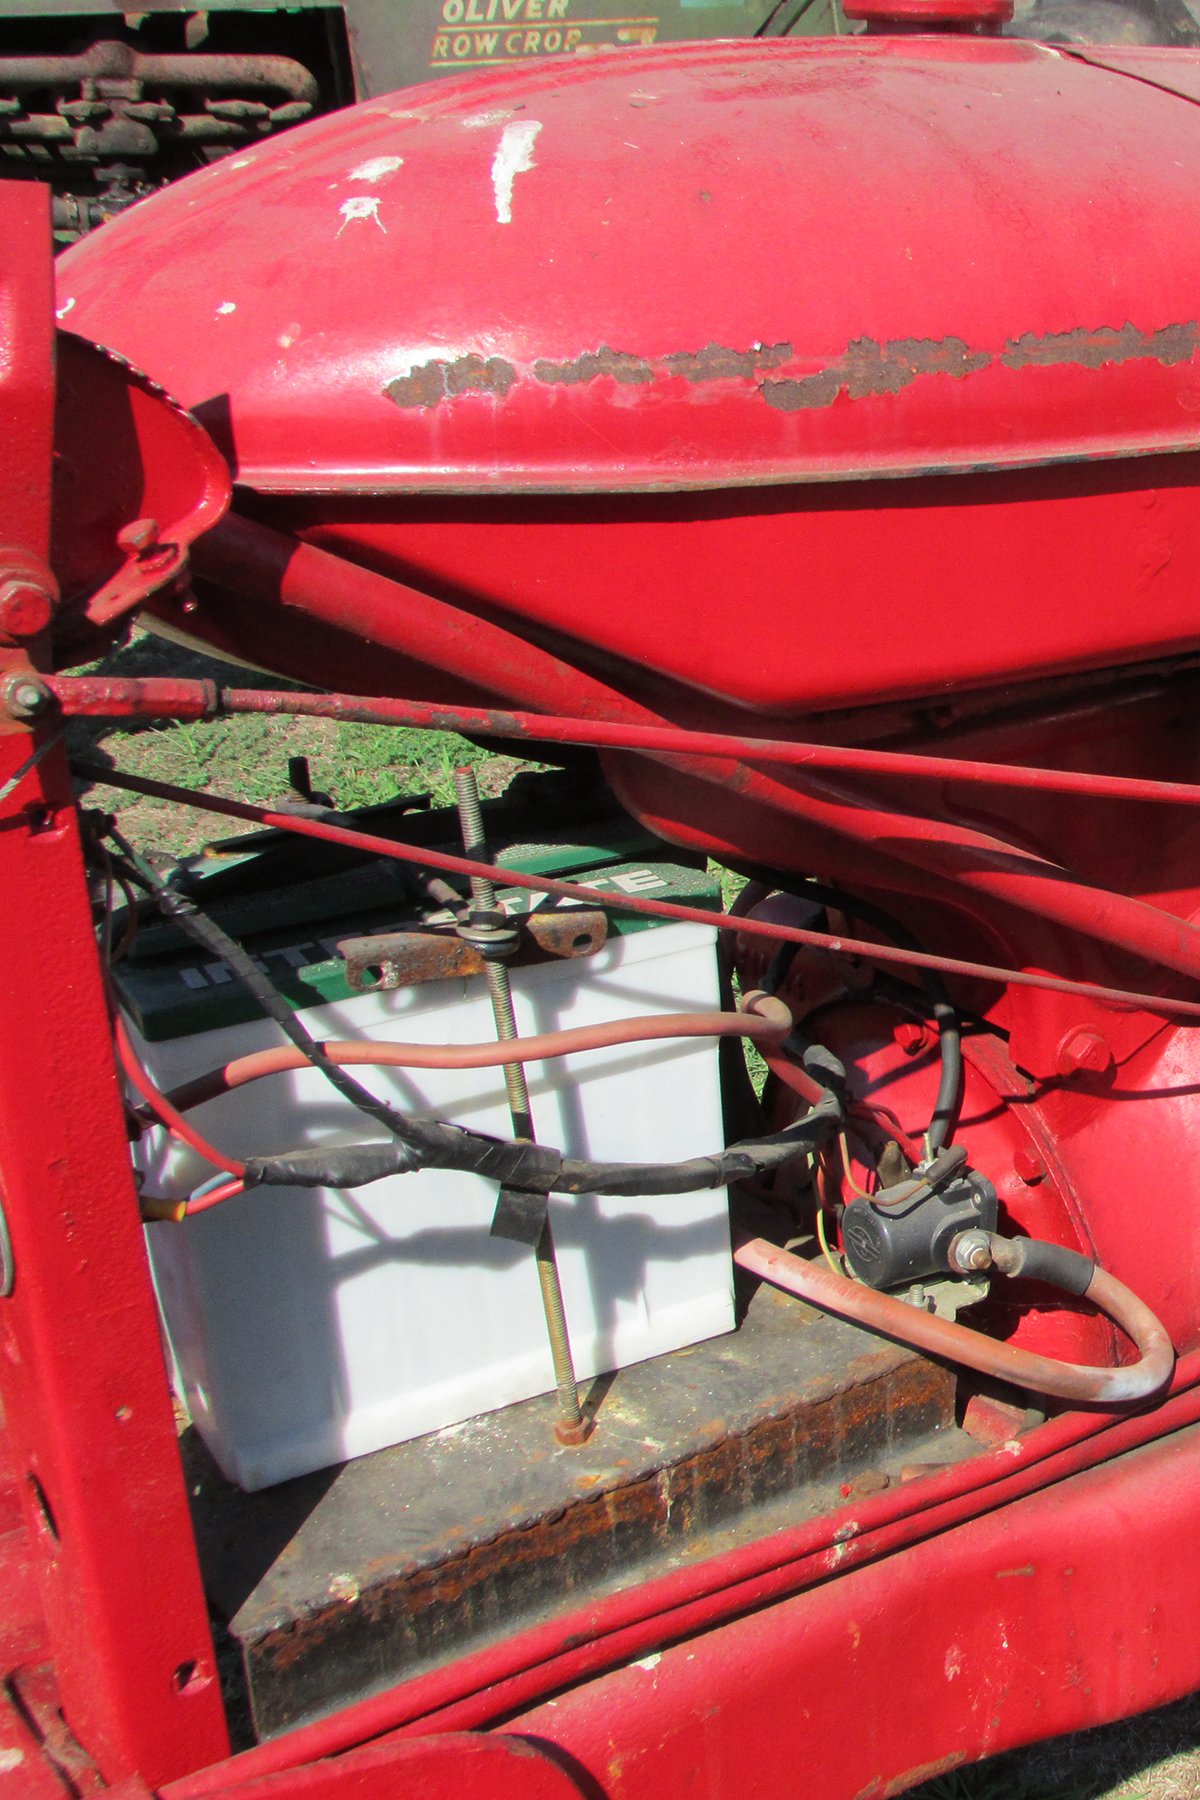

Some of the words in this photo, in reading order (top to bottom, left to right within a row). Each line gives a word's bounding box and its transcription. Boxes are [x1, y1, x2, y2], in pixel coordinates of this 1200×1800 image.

[441, 0, 570, 23] OLIVER
[432, 31, 500, 58] ROW
[504, 28, 582, 54] CROP
